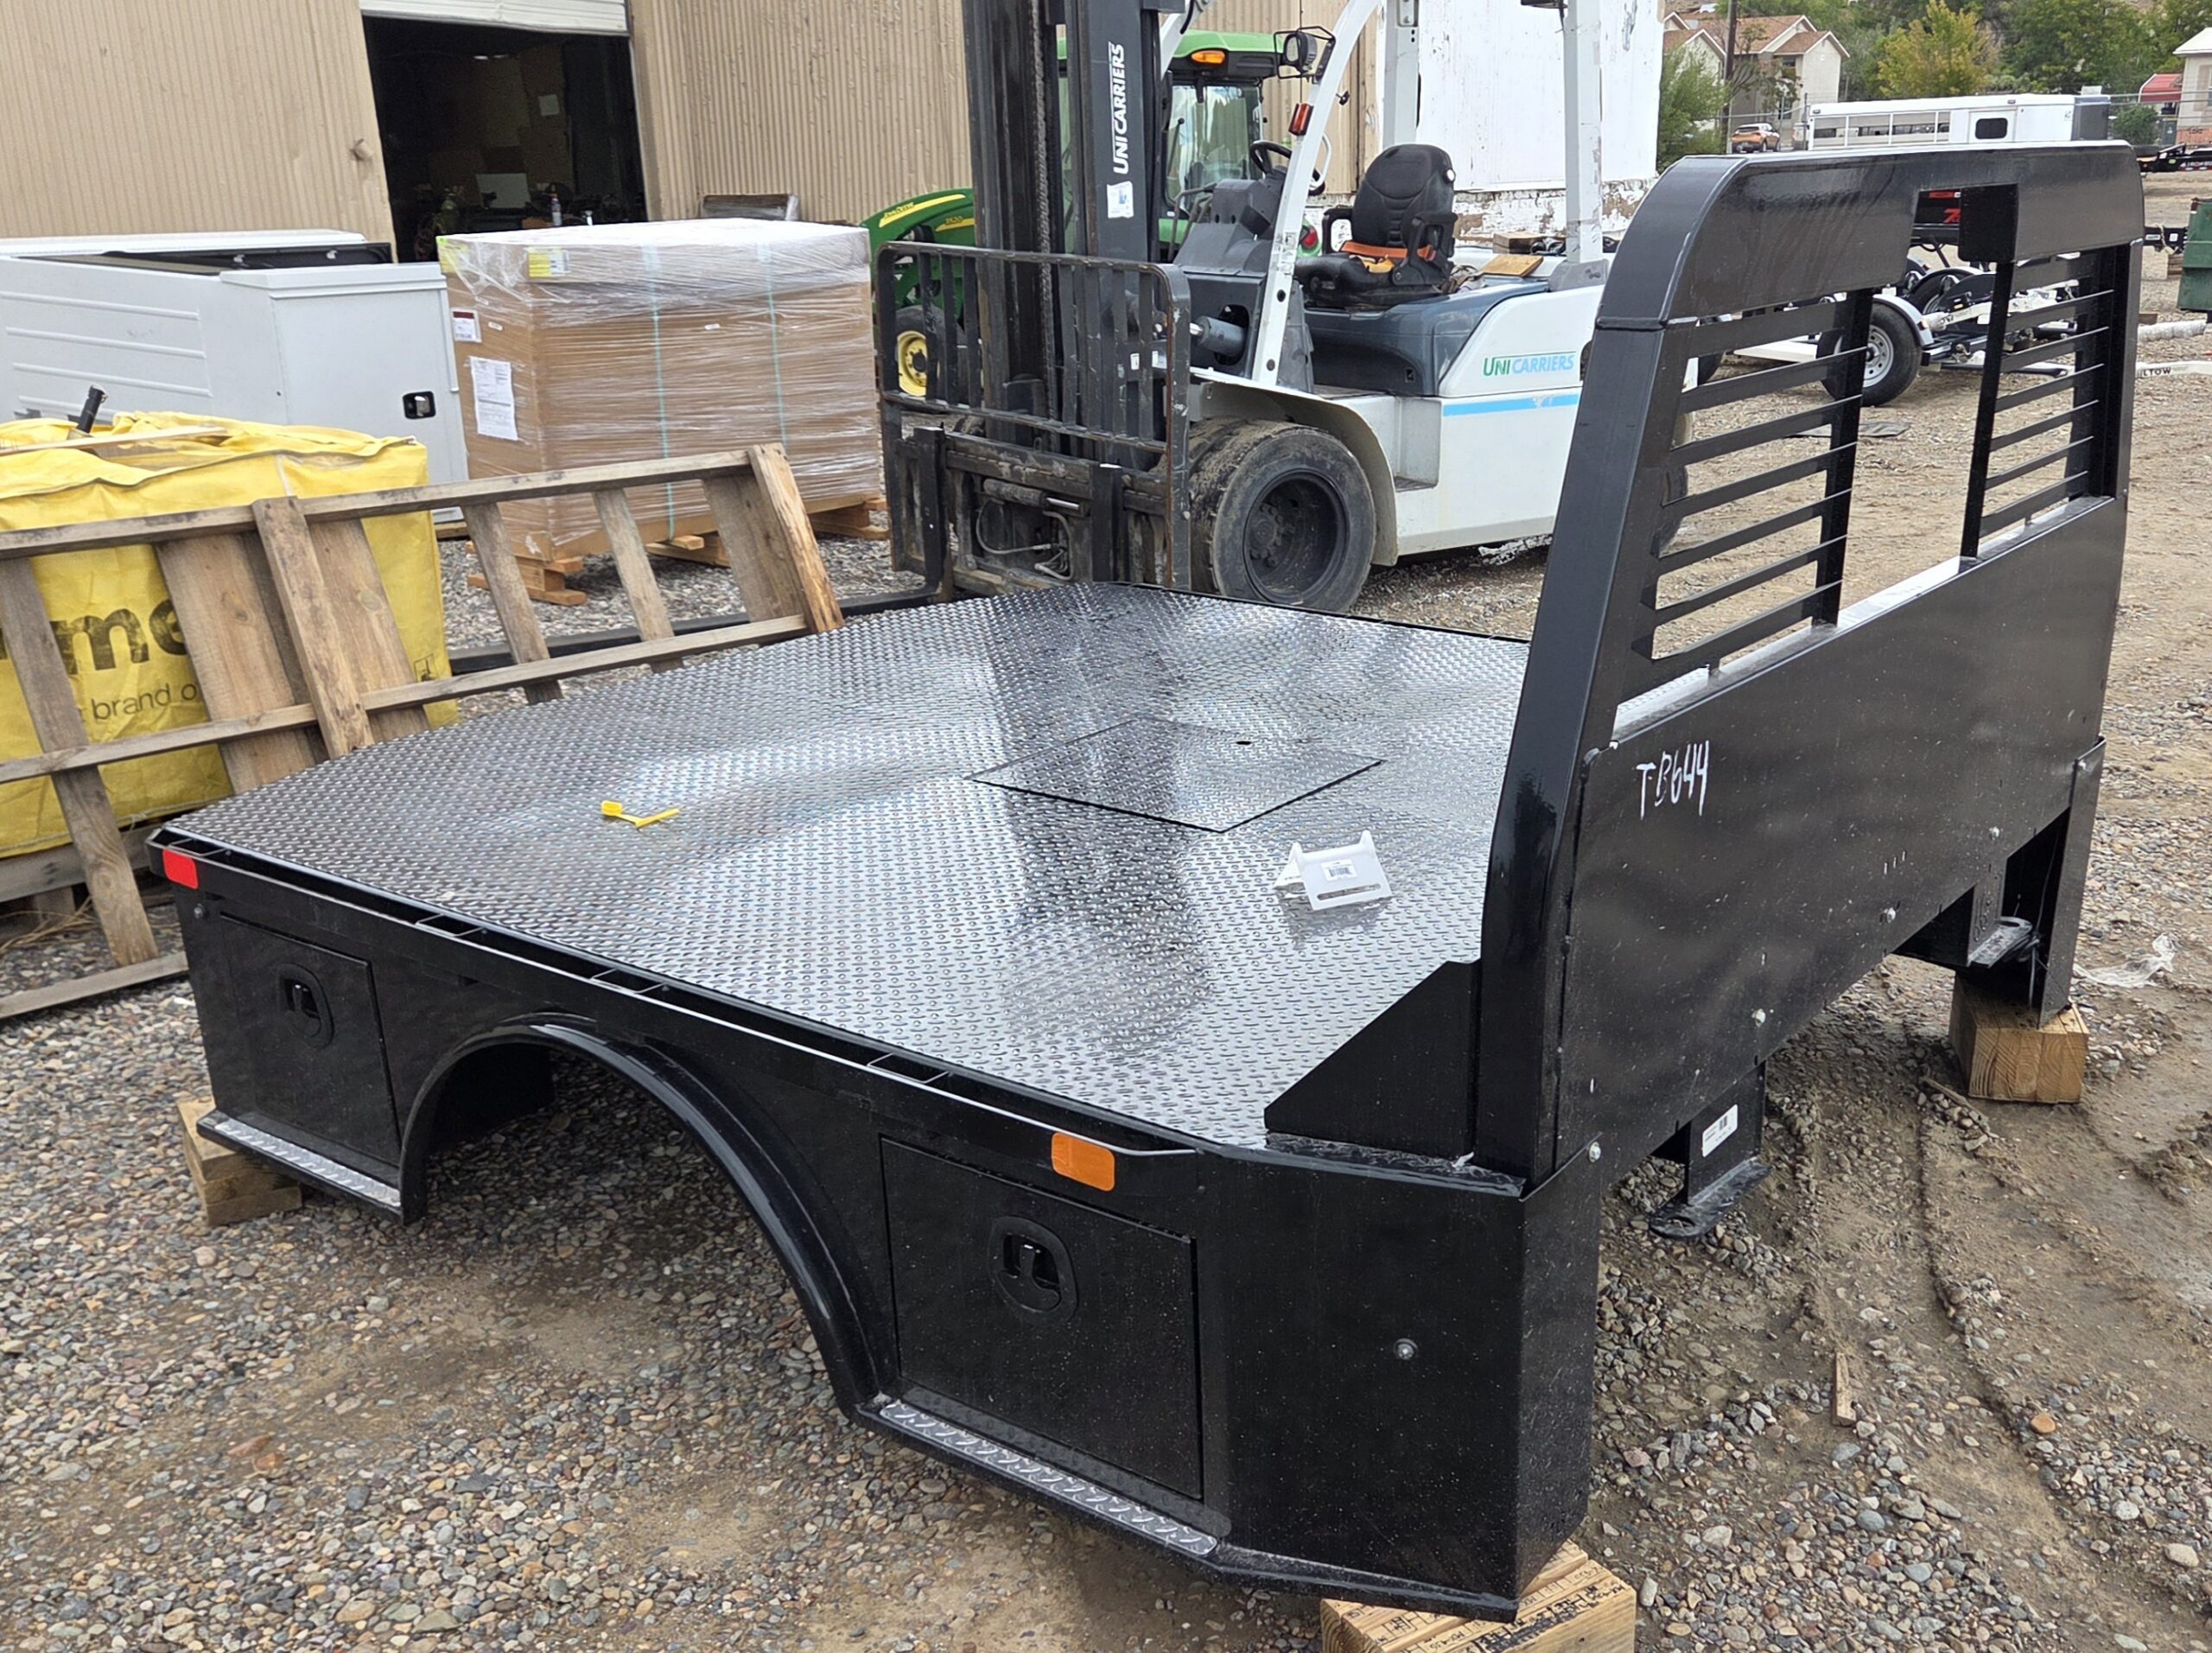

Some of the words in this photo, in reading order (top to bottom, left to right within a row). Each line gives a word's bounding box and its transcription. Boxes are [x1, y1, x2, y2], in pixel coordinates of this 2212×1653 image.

[1109, 41, 1128, 175] UNICARRIERS
[1483, 352, 1576, 377] UNICARRIERS
[92, 683, 171, 720] brand
[181, 683, 197, 702] o
